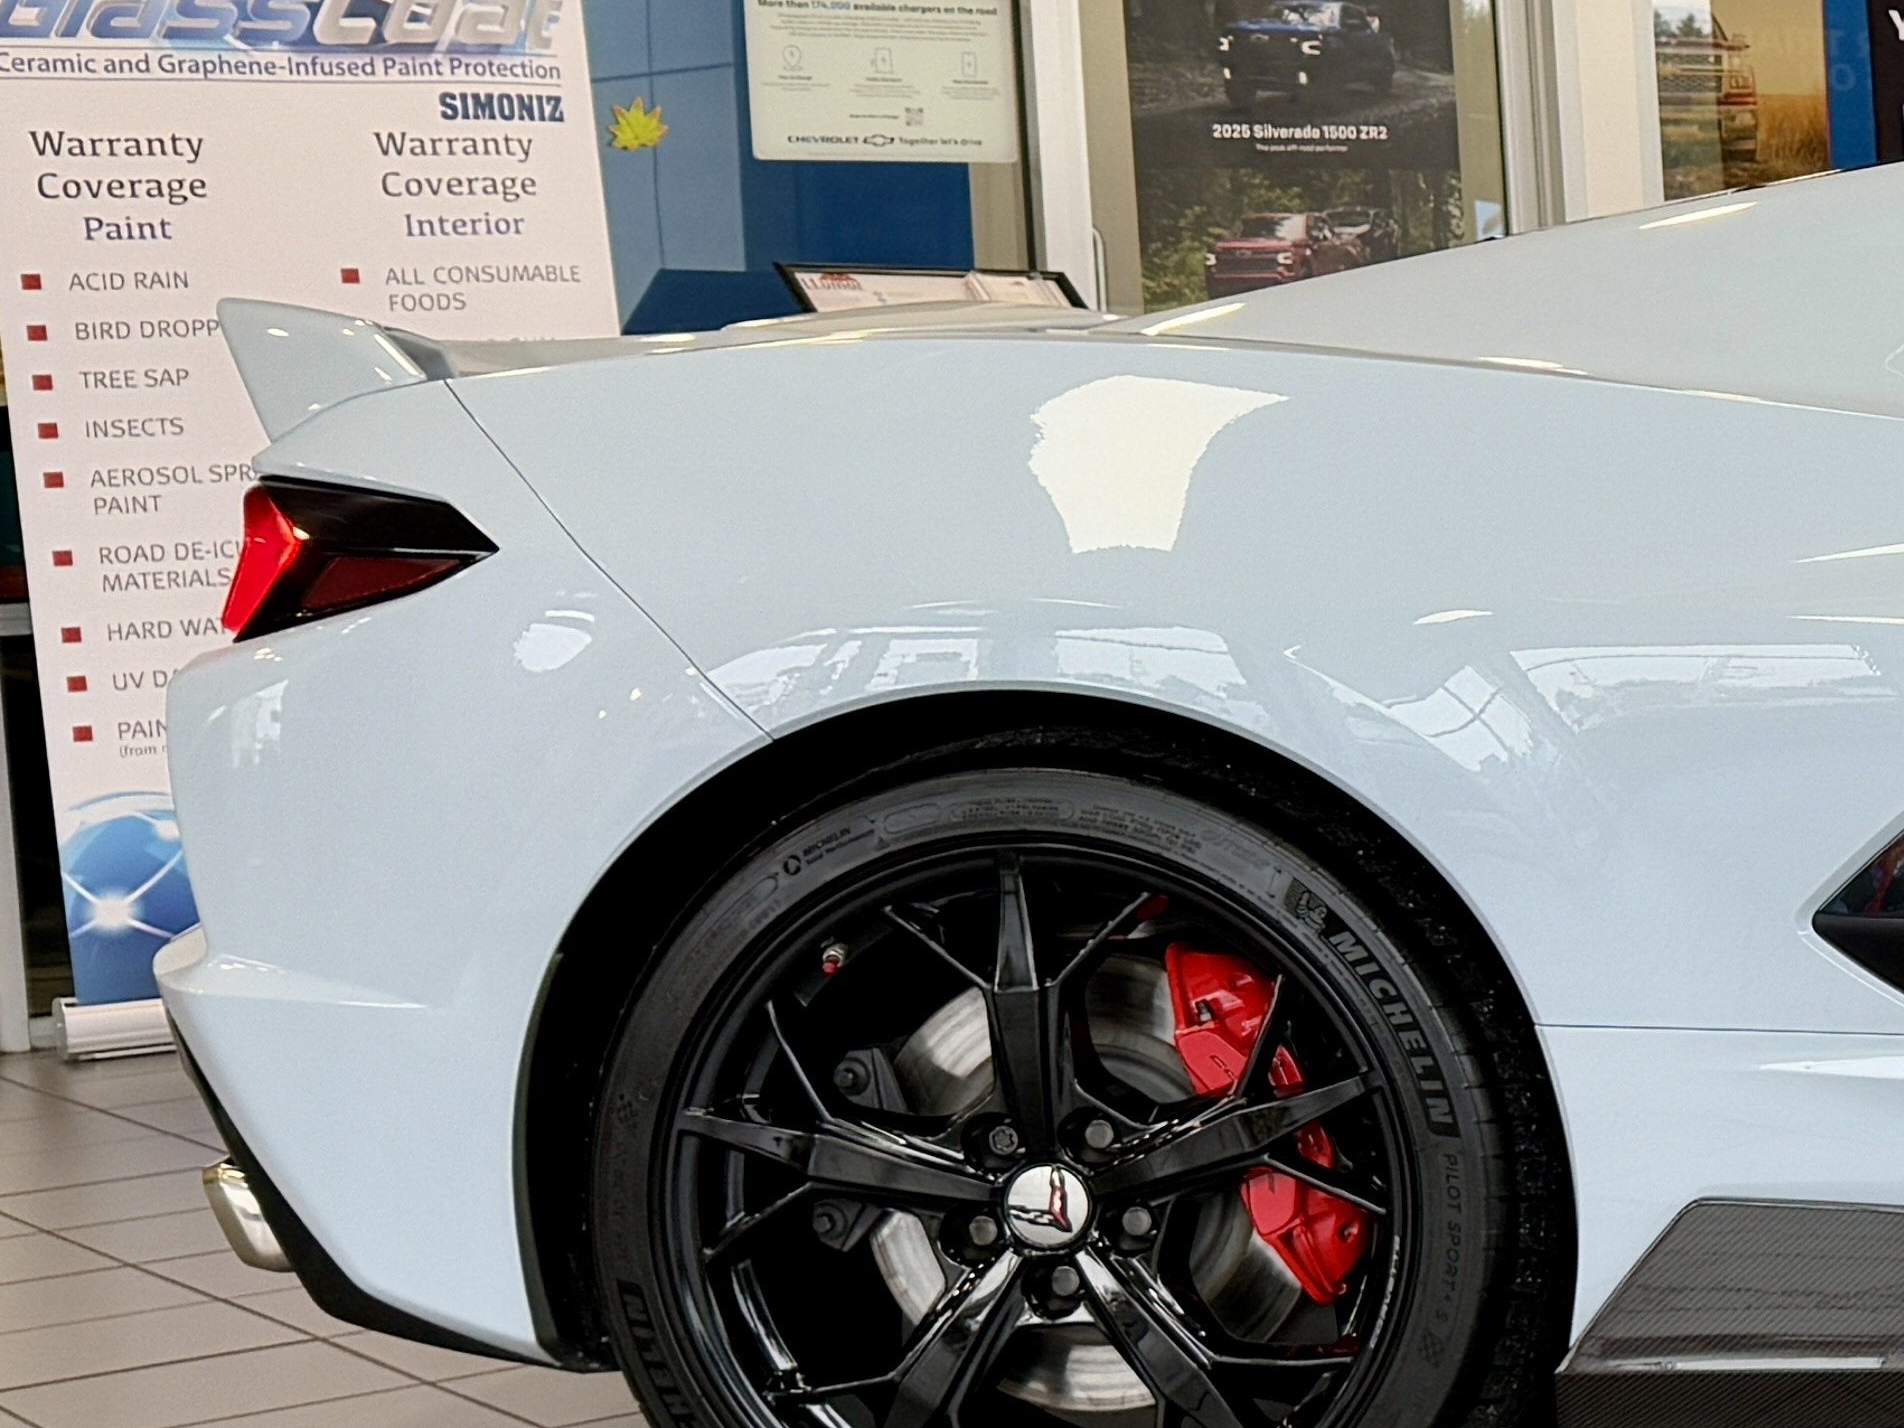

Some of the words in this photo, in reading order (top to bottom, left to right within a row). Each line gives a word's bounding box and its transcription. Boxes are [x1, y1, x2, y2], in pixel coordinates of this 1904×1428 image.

[898, 3, 942, 15] chargers
[957, 6, 973, 15] the
[975, 7, 998, 16] road
[0, 51, 97, 74] Ceramic
[103, 53, 151, 75] and
[157, 53, 377, 80] Graphene-Infused
[383, 55, 443, 78] Paint
[449, 58, 562, 81] Protection
[439, 92, 565, 123] SIMONIZ
[787, 134, 859, 145] CHEVROLET
[1212, 124, 1250, 139] 2025
[1252, 124, 1320, 139] Silverado
[1322, 125, 1357, 140] 1500
[1359, 125, 1389, 140] ZR2
[29, 131, 204, 164] Warranty
[375, 132, 533, 163] Warranty
[37, 173, 208, 206] Coverage
[381, 172, 538, 203] Coverage
[83, 216, 173, 242] Paint
[405, 212, 525, 237] Interior
[69, 273, 125, 292] ACID
[133, 271, 189, 291] RAIN
[386, 266, 426, 286] ALL
[433, 265, 581, 285] CONSUMABLE
[389, 292, 467, 312] FOODS
[75, 321, 131, 341] BIRD
[140, 319, 220, 338] DROPP
[80, 370, 137, 390] TREE
[144, 368, 189, 388] SAP
[85, 418, 184, 438] INSECTS
[90, 465, 203, 488] AEROSOL
[208, 464, 252, 483] SPR
[94, 495, 162, 515] PAINT
[99, 544, 165, 565] ROAD
[102, 568, 230, 593] MATERIALS
[107, 621, 172, 641] HARD
[112, 672, 144, 691] UV
[118, 720, 168, 740] PAIN
[1329, 931, 1453, 1126] MICHELIN
[1443, 1153, 1462, 1213] PILOT
[1441, 1218, 1463, 1290] SPORT
